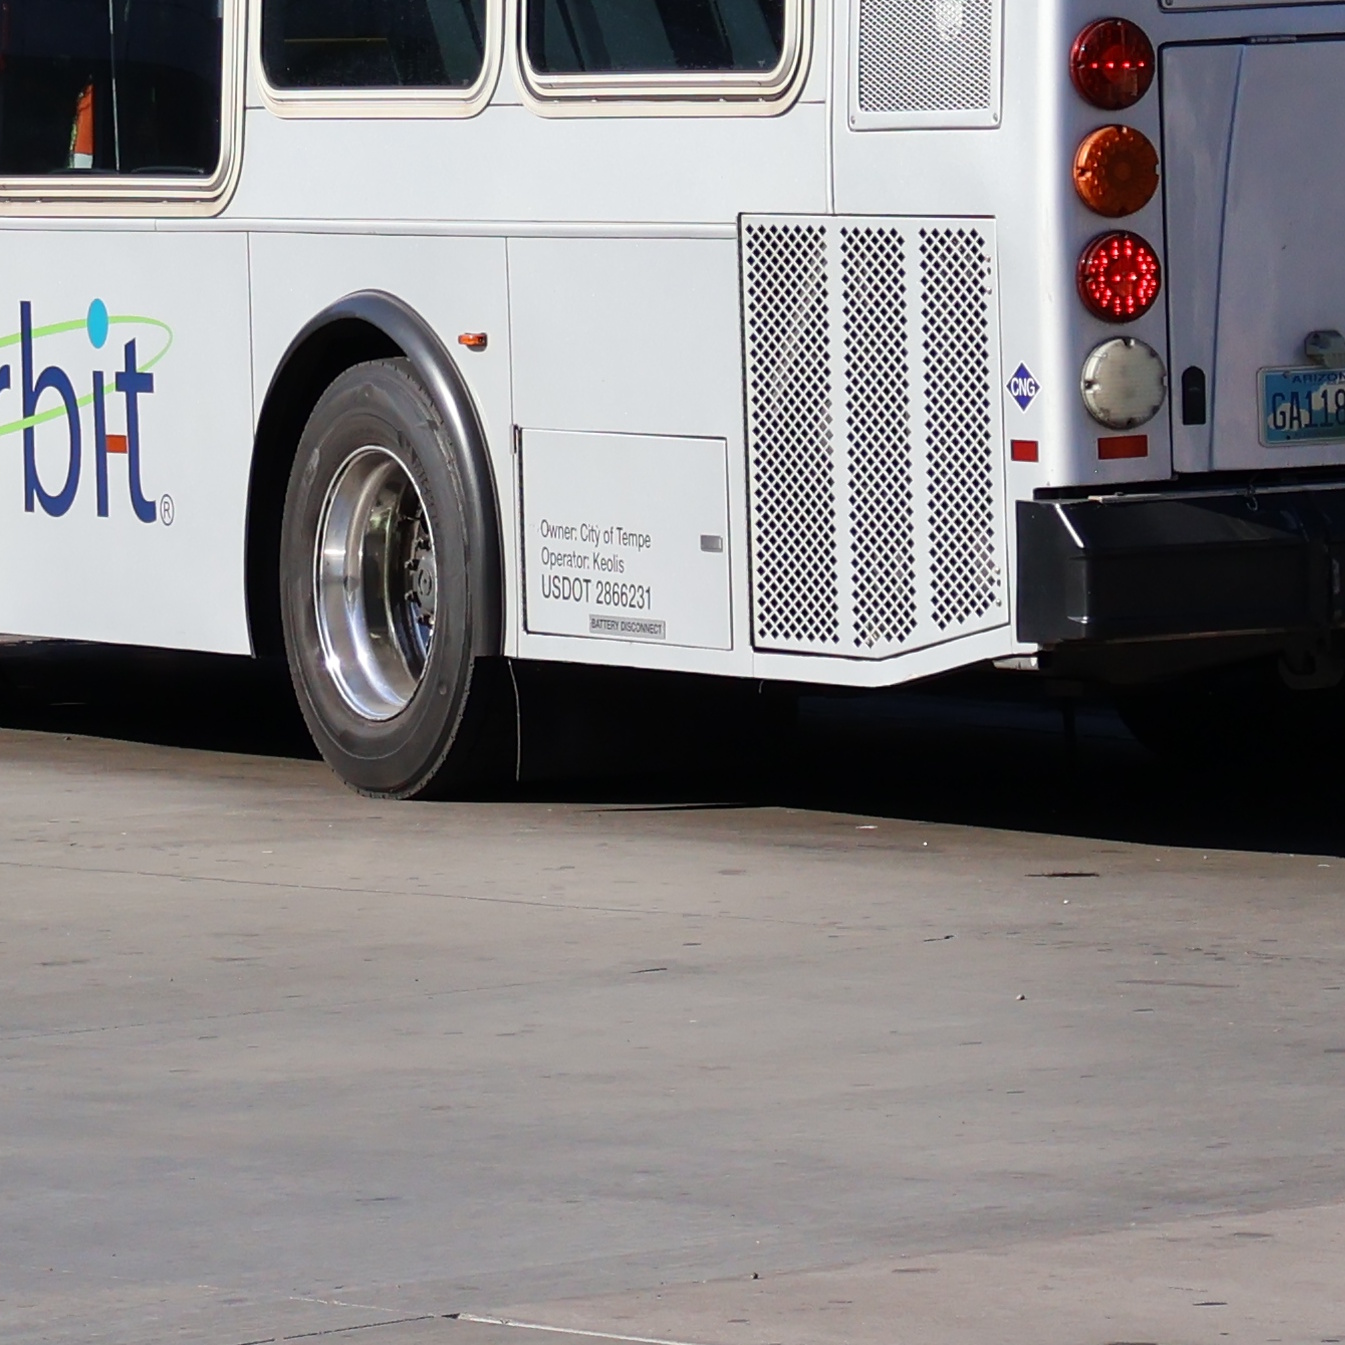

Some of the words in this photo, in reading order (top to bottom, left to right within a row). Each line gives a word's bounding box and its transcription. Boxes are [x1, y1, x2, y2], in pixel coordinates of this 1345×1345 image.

[1010, 377, 1036, 397] CNG
[540, 519, 577, 541] Owner:
[580, 523, 601, 548] City
[603, 526, 614, 544] of
[616, 526, 652, 552] Tempe
[541, 546, 590, 570] Operator:
[593, 552, 625, 574] Keolis
[541, 574, 592, 603] USDOT
[596, 580, 651, 611] 2866231
[591, 618, 620, 631] BATTERY
[620, 621, 662, 635] DISCONNECT
